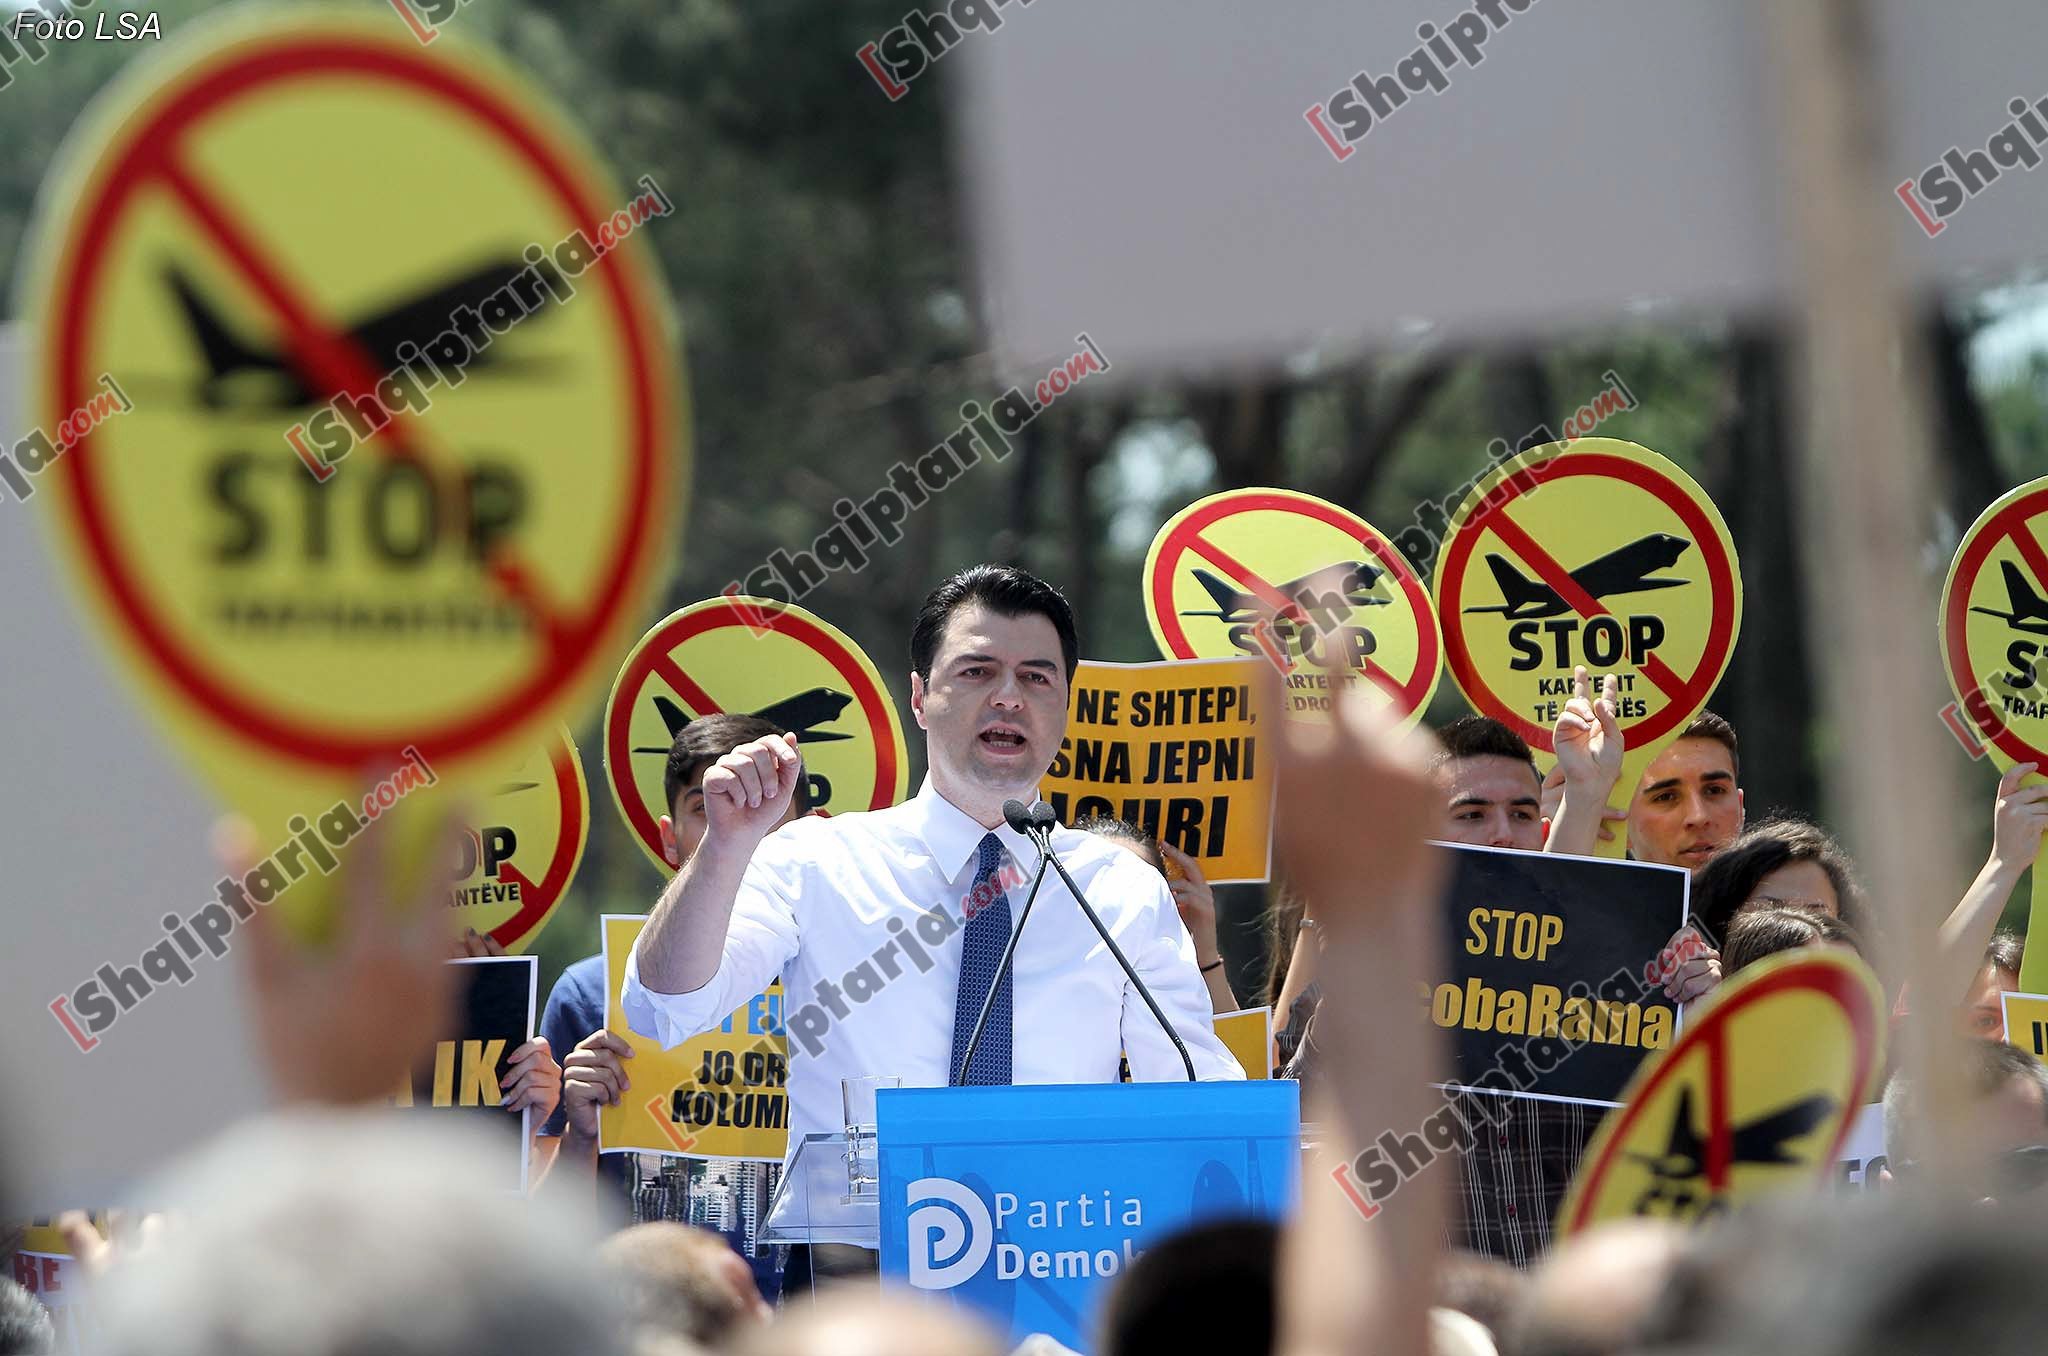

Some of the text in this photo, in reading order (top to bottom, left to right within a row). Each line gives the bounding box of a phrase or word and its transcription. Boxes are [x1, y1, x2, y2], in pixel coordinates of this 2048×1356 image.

[203, 452, 529, 572] STOP
[1228, 624, 1377, 668] STOP
[1508, 615, 1665, 671] STOP
[2003, 640, 2048, 689] S
[1076, 685, 1256, 727] NE SHTEPI,
[1143, 736, 1256, 784] JEPNI
[1465, 907, 1564, 961] STOP
[698, 1050, 735, 1086] JO
[671, 1089, 789, 1130] KOLUM
[995, 1190, 1143, 1230] Partia
